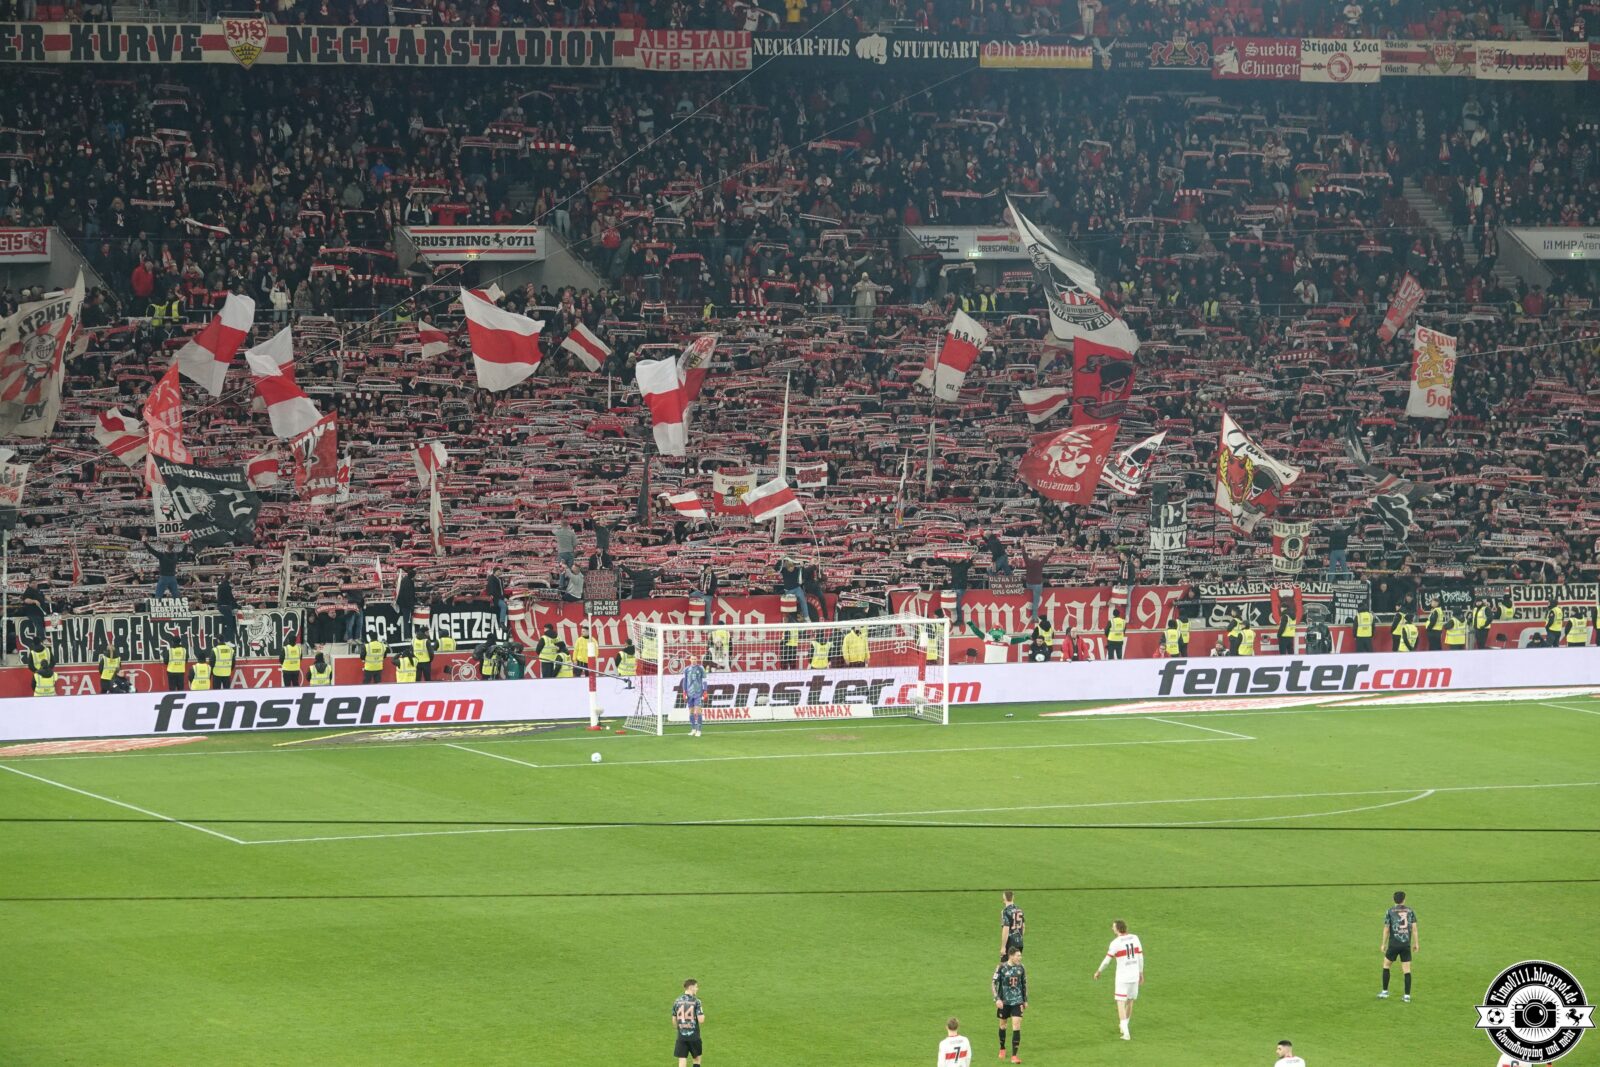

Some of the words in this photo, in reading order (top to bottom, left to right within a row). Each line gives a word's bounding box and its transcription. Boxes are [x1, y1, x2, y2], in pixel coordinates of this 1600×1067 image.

[70, 25, 202, 62] KURVE
[286, 26, 615, 65] NECKARSTADION
[638, 30, 750, 49] ALBSTADT
[753, 37, 850, 57] NECKAR-FILS
[893, 40, 980, 59] STUTTGART
[1301, 39, 1348, 55] Brigada
[1352, 40, 1379, 52] Loca
[984, 39, 1015, 60] Old
[1021, 38, 1094, 60] Warriors
[1245, 42, 1297, 58] Suebia
[641, 50, 748, 69] VFB-FANS
[412, 235, 491, 247] BRUSTRING
[506, 236, 535, 247] 0711
[1555, 240, 1578, 250] MHP
[1200, 582, 1273, 596] SCHWABEN
[149, 598, 189, 606] ULTRAS
[1157, 659, 1452, 696] fenster.com
[153, 691, 484, 734] fenster.com
[793, 704, 852, 718] WINAMAX
[1012, 911, 1024, 930] 15
[1397, 911, 1409, 929] 3
[1125, 943, 1135, 960] 11
[676, 1004, 695, 1022] 44
[953, 1046, 961, 1064] 7
